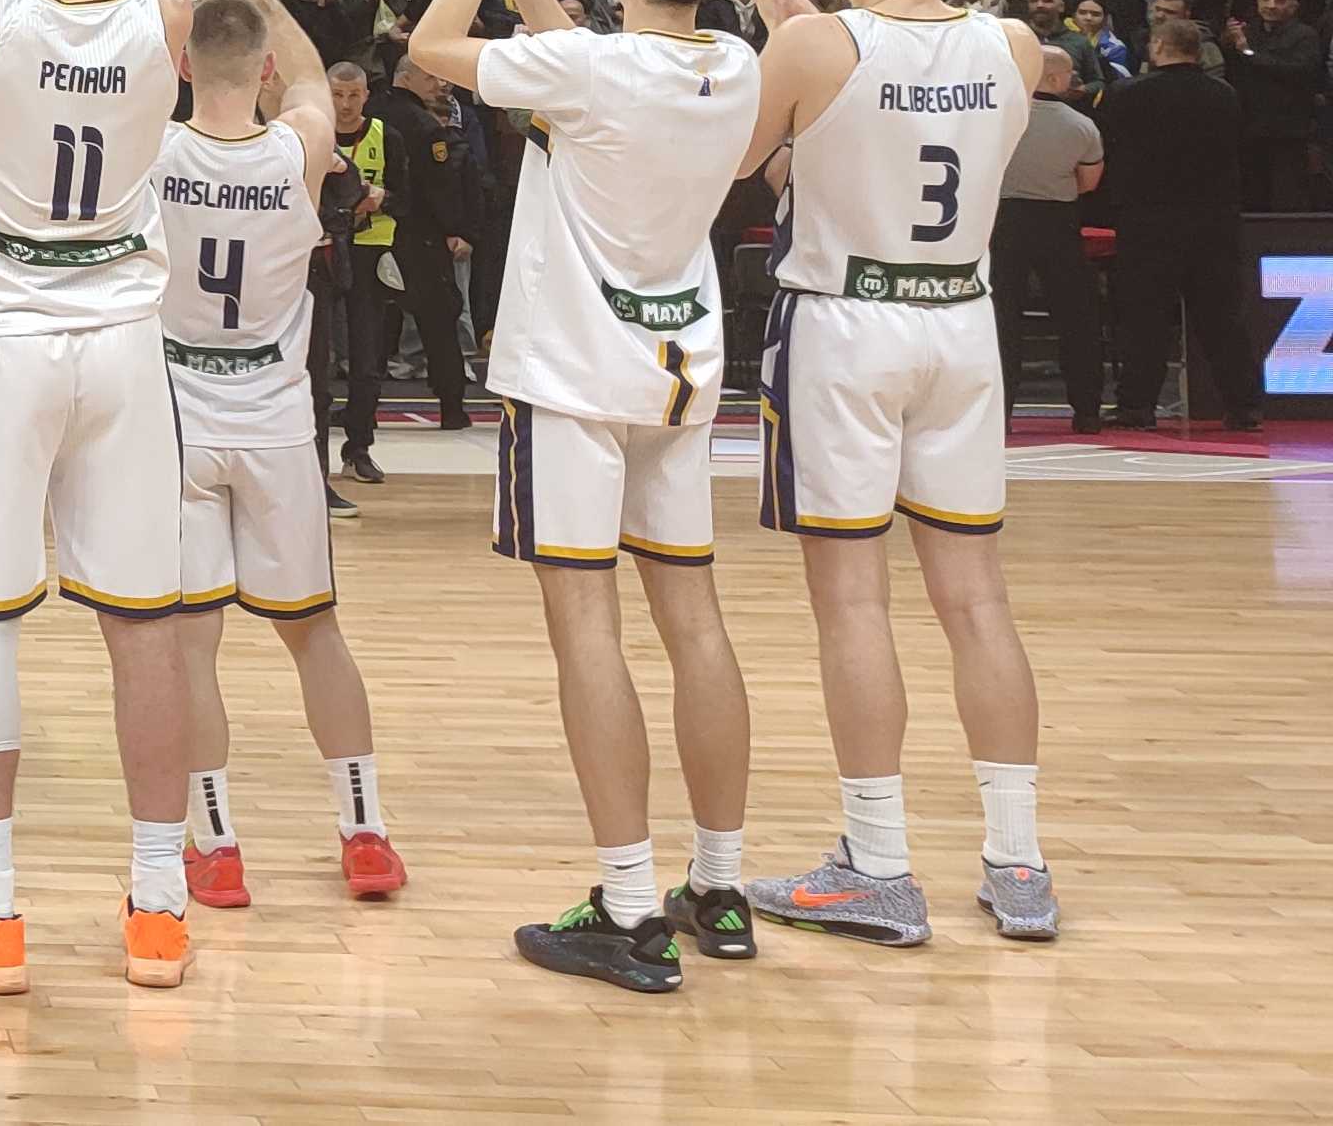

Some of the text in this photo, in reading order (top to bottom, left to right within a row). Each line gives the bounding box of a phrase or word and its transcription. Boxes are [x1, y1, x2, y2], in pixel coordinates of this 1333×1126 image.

[50, 123, 104, 221] 11
[162, 175, 291, 211] ARSLANAGIĆ
[910, 144, 962, 243] 3
[197, 237, 246, 330] 4
